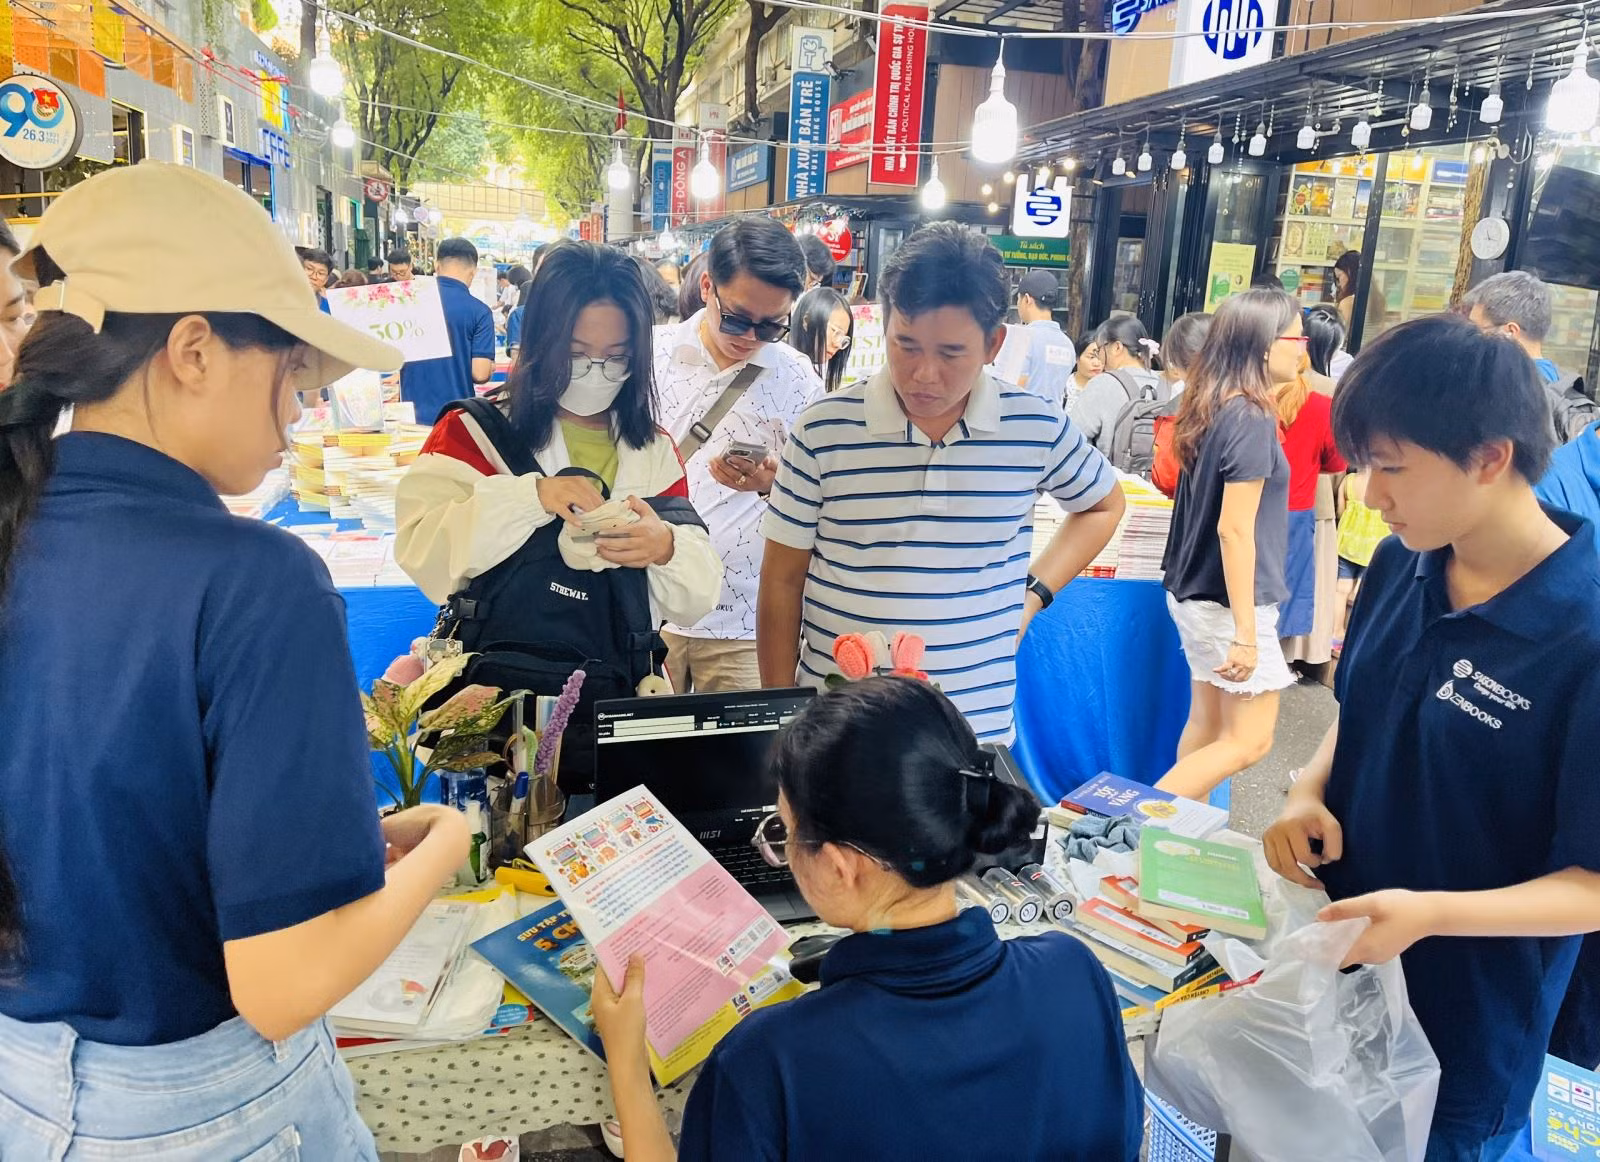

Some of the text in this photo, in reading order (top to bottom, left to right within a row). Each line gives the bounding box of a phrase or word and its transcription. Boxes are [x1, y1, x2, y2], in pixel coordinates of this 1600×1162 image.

[893, 30, 905, 46] SỰ
[892, 46, 903, 60] GIA
[888, 60, 903, 82] QUỐC
[904, 45, 914, 91] PUBLISHING
[797, 80, 814, 105] TRẺ
[890, 82, 902, 95] TRỊ
[887, 94, 900, 118] CHÍNH
[901, 93, 911, 132] POLITICAL
[795, 108, 813, 135] BẢN
[885, 119, 897, 135] BẢN
[677, 150, 687, 159] A
[794, 172, 810, 200] NHÀ
[552, 919, 578, 939] CH
